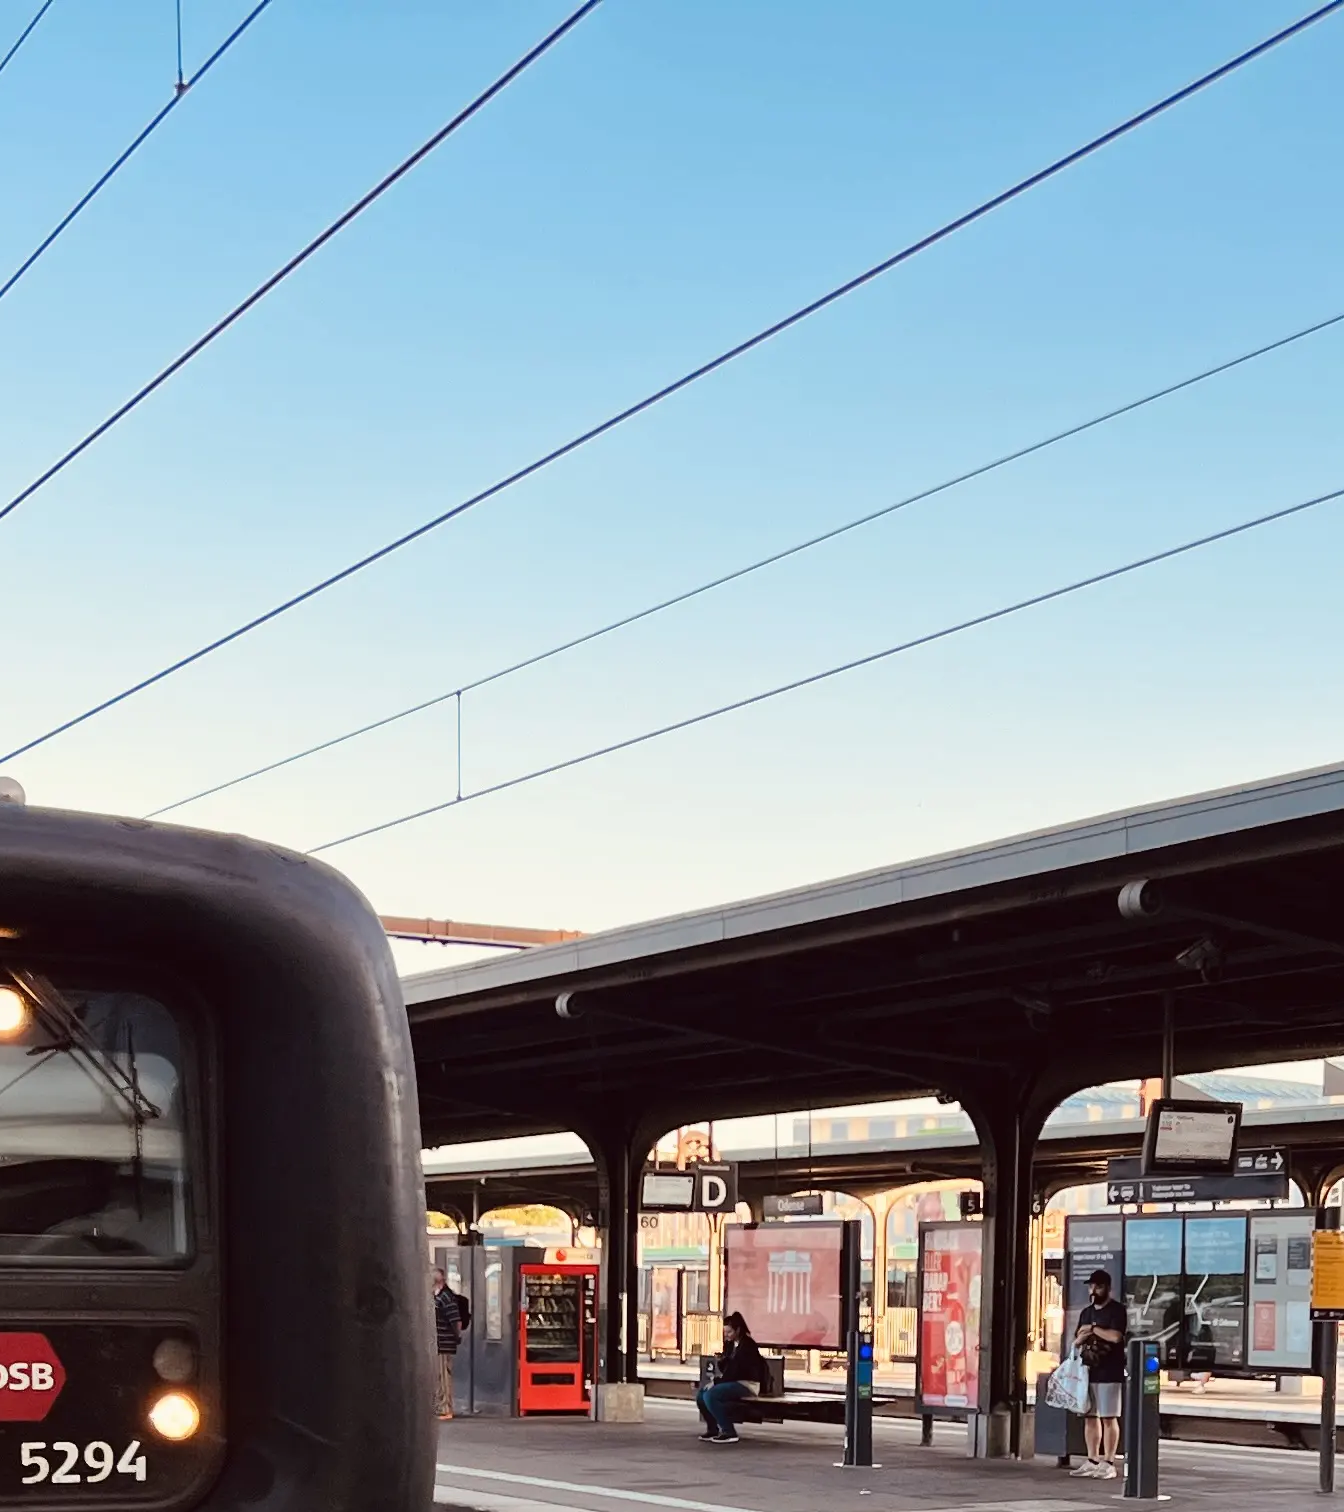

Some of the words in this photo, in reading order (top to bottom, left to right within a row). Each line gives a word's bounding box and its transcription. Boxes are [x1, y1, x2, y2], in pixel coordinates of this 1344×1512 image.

[701, 1175, 727, 1207] D
[777, 1198, 805, 1212] Odense
[967, 1199, 976, 1212] 5
[1032, 1200, 1041, 1213] 6
[640, 1215, 659, 1229] 60
[20, 1440, 148, 1485] 5294
